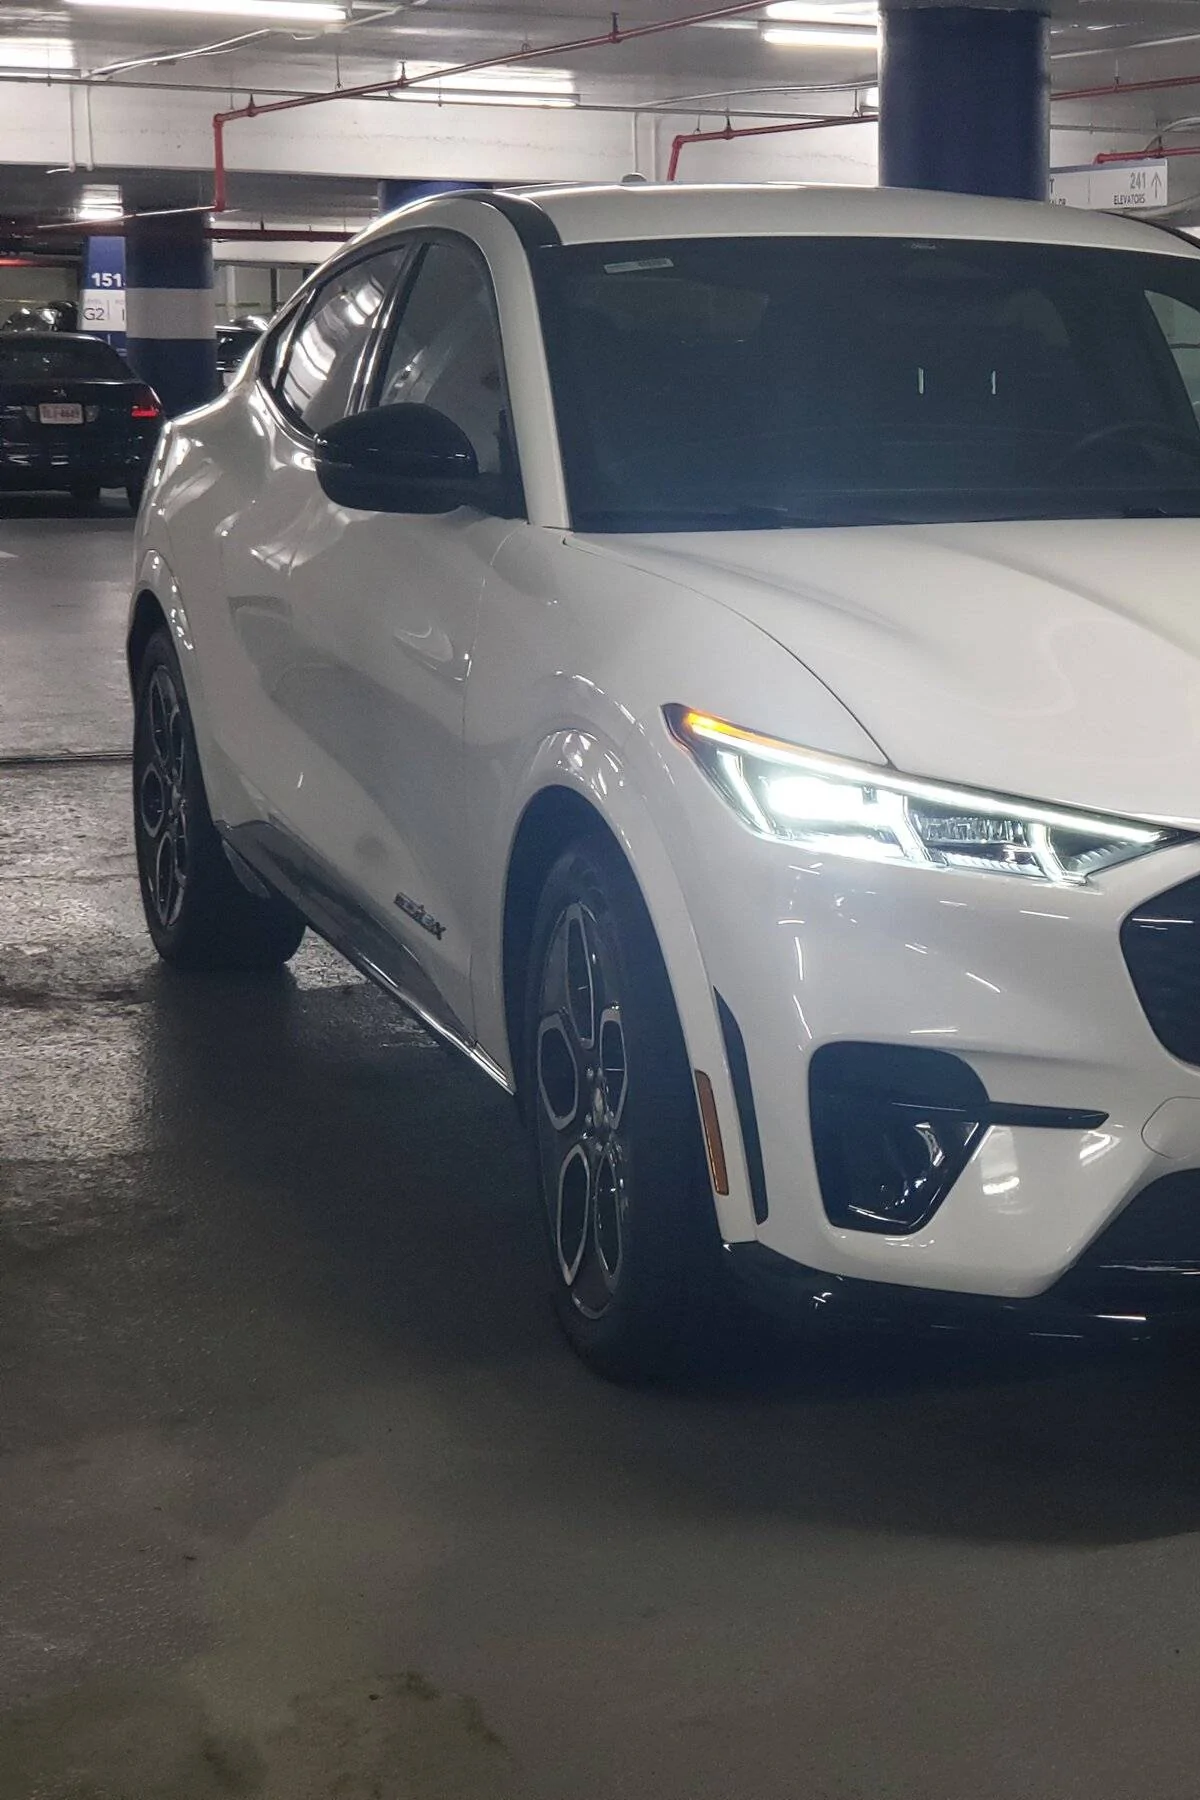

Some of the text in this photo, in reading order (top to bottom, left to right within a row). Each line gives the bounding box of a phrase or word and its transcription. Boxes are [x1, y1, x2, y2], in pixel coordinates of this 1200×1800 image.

[1130, 172, 1146, 189] 241
[1113, 193, 1146, 205] ELEVATORS
[91, 272, 126, 288] 151
[83, 307, 105, 321] G2
